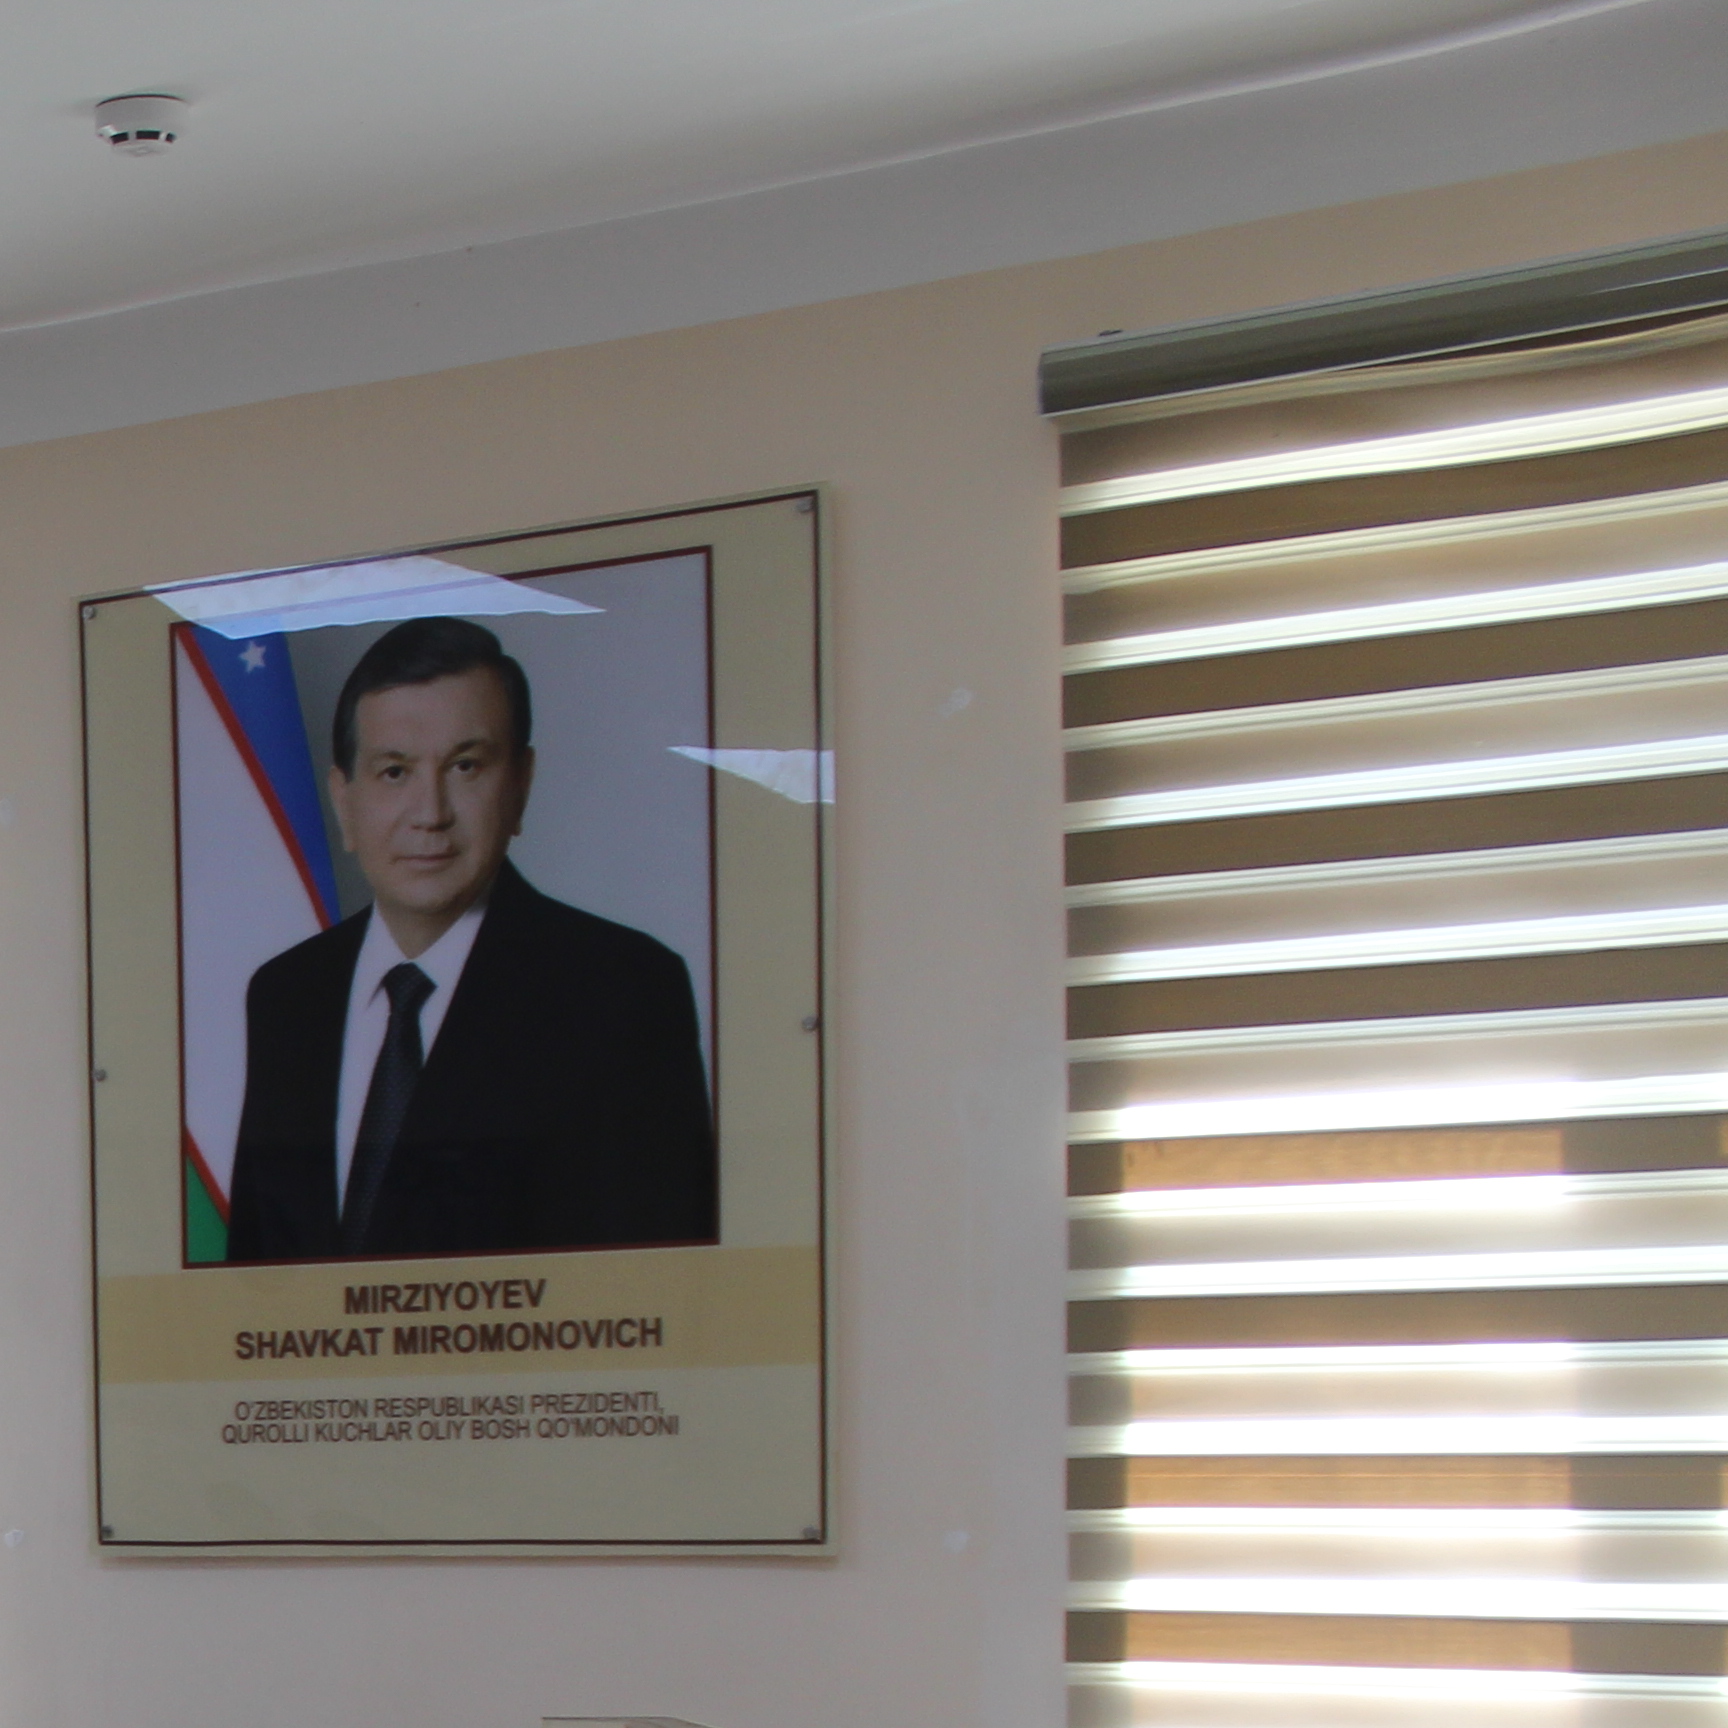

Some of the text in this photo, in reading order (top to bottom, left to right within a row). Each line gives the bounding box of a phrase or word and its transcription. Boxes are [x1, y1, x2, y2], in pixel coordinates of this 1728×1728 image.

[344, 1278, 546, 1314] MIRZIYOYEV
[235, 1317, 663, 1360] SHAVKAT MIROMONOVICH
[374, 1395, 524, 1419] RESPUBLIKASI
[531, 1391, 664, 1415] PREZIDENTI,
[222, 1423, 309, 1444] QUROLLI
[314, 1420, 412, 1442] KUCHLAR
[418, 1419, 465, 1441] OLIY
[470, 1418, 531, 1440] BOSH
